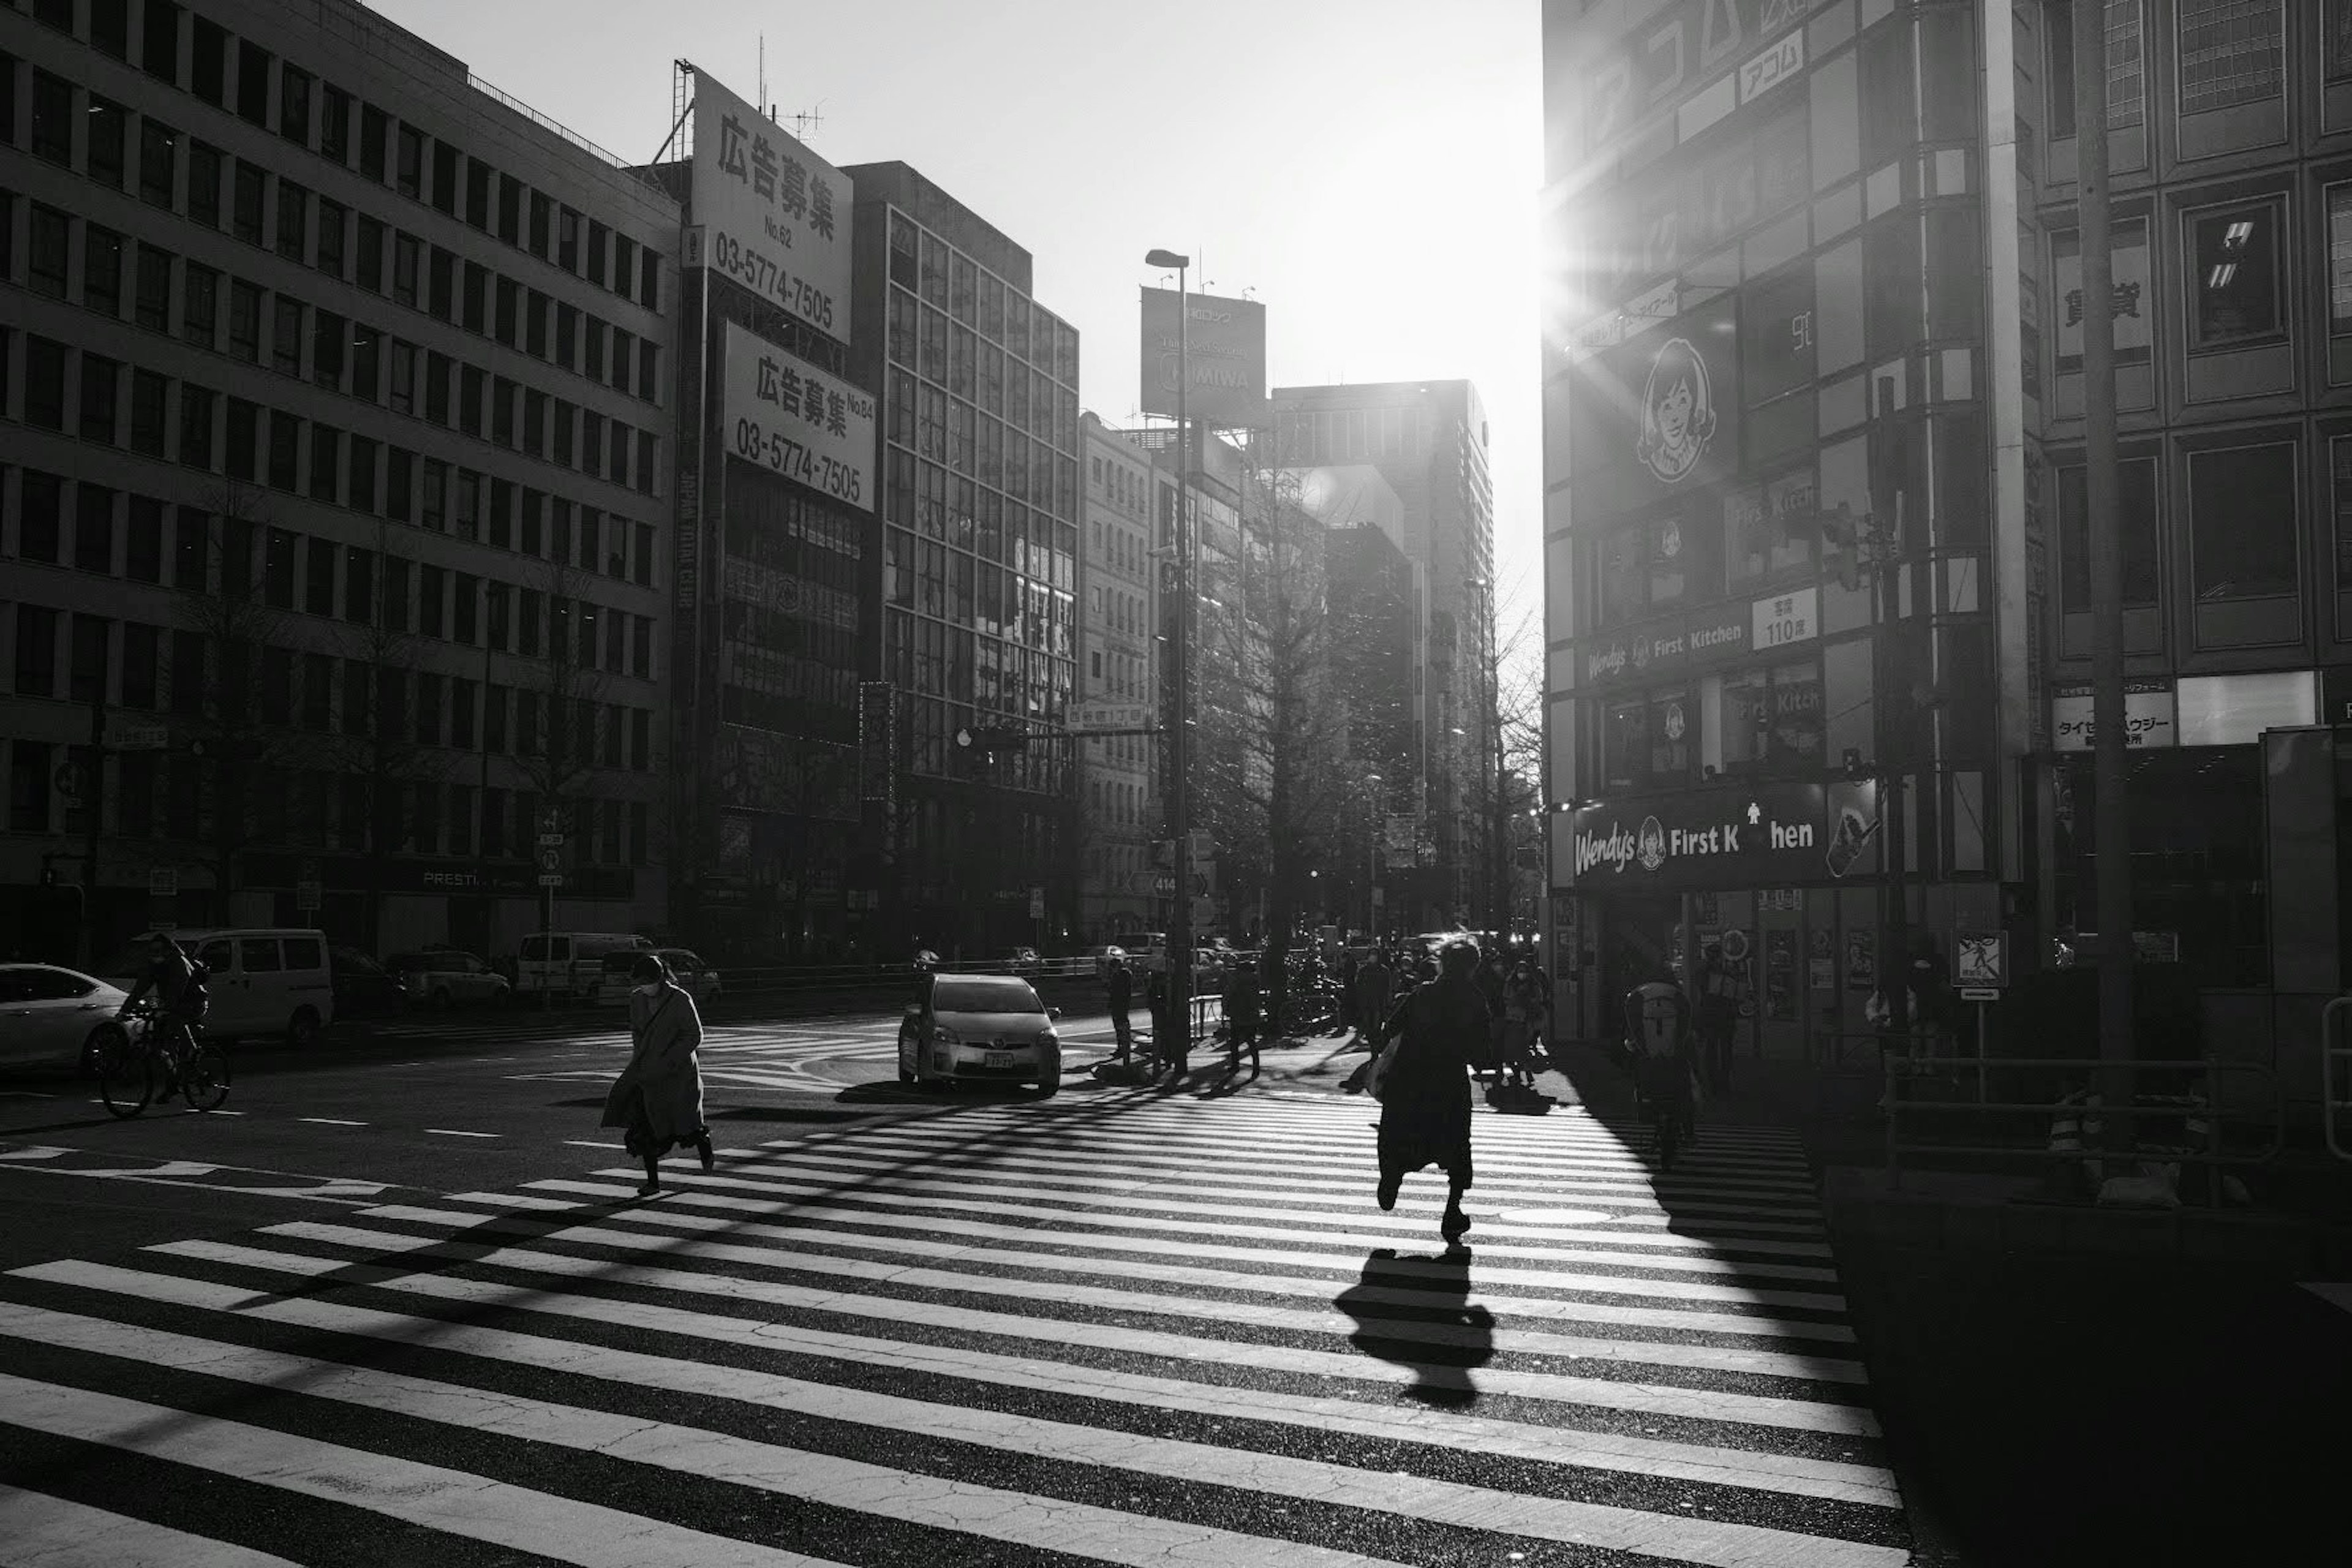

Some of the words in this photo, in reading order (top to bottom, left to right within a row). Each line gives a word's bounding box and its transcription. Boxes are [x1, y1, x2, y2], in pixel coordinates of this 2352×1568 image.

[1747, 44, 1798, 96] アコム
[718, 115, 834, 241] 広告募集
[765, 214, 791, 249] No.62
[717, 232, 832, 329] 03-5774-7505
[757, 356, 846, 439] 広告募集
[1196, 368, 1249, 390] MIWA
[847, 393, 873, 420] No.84
[737, 418, 860, 502] 03-5774-7505
[1589, 643, 1626, 680] Wendy's
[1654, 636, 1683, 657] First
[1691, 625, 1741, 649] Kitchen
[2059, 717, 2169, 736] タイセウジー
[1575, 820, 1635, 876] Wendy's
[1671, 825, 1718, 856] First
[1722, 820, 1814, 853] Khen
[1155, 876, 1177, 892] 414
